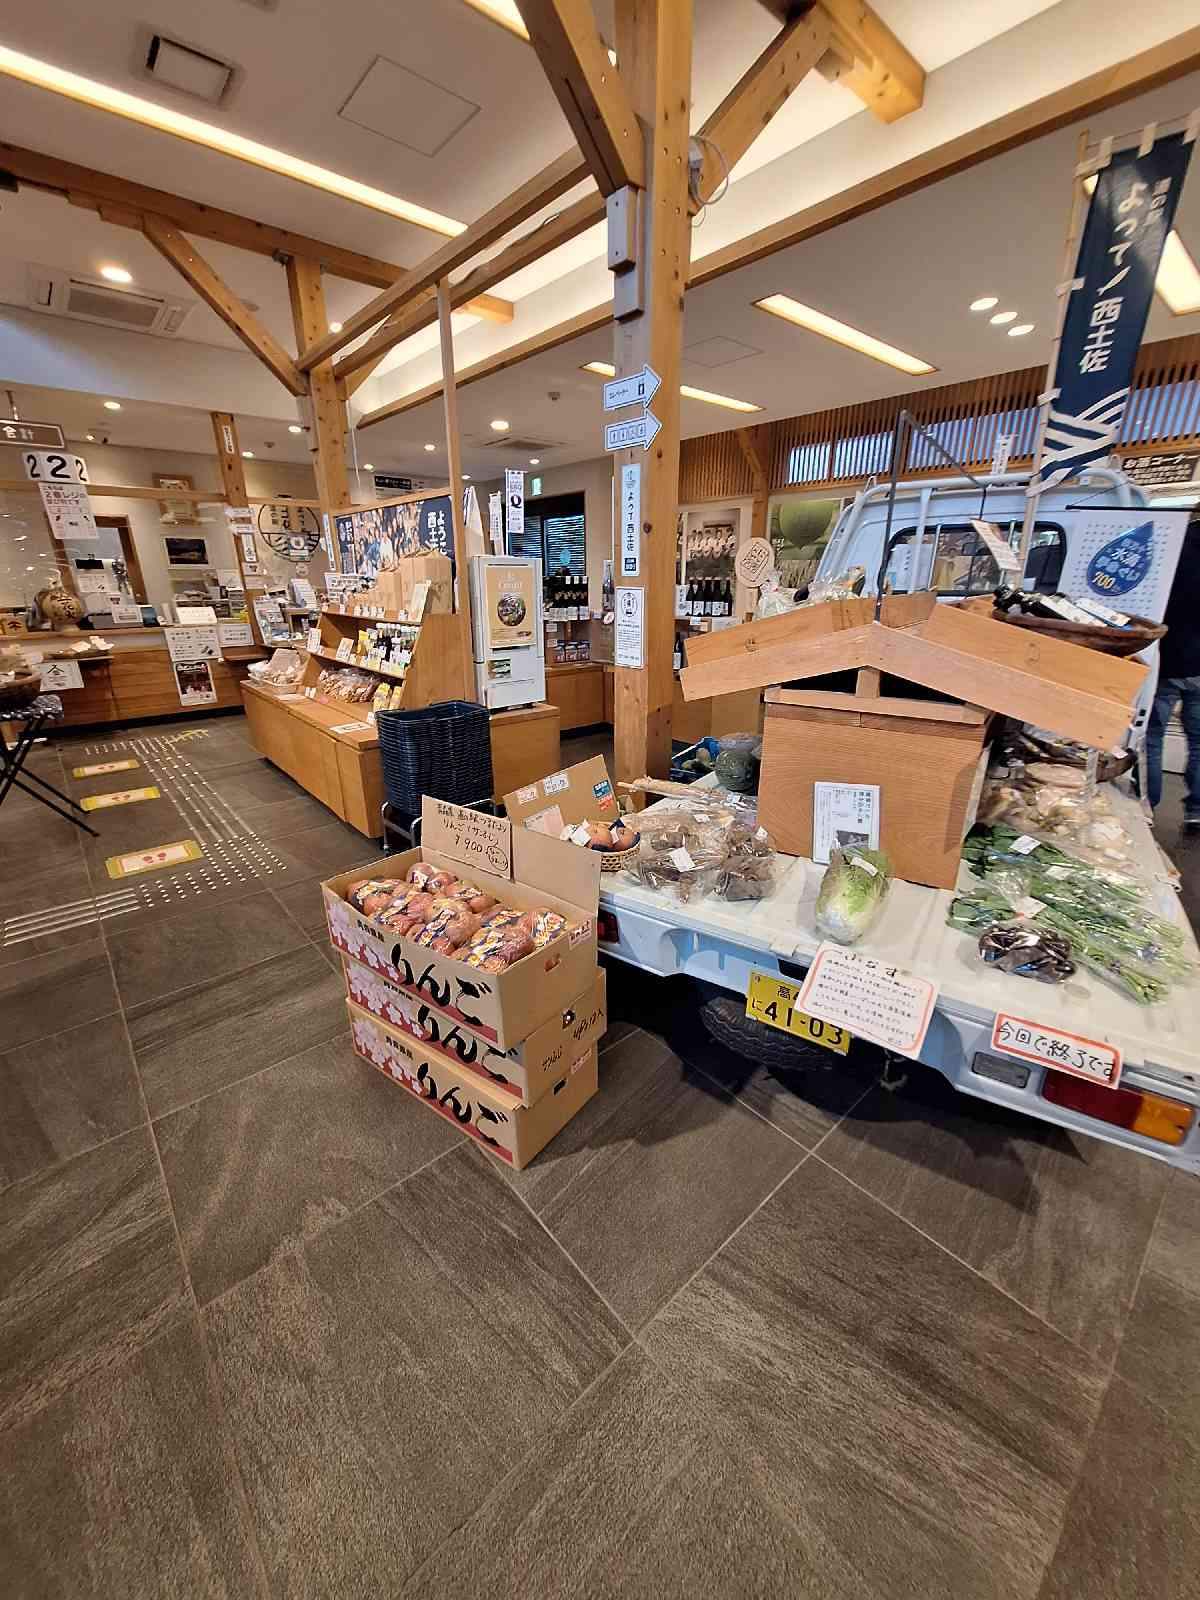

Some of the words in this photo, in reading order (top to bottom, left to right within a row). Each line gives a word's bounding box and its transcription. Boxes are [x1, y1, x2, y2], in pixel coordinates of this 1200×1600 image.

[27, 454, 41, 478] 2
[47, 455, 71, 478] 2
[391, 943, 492, 1027] りんご
[416, 1062, 509, 1146] りんご
